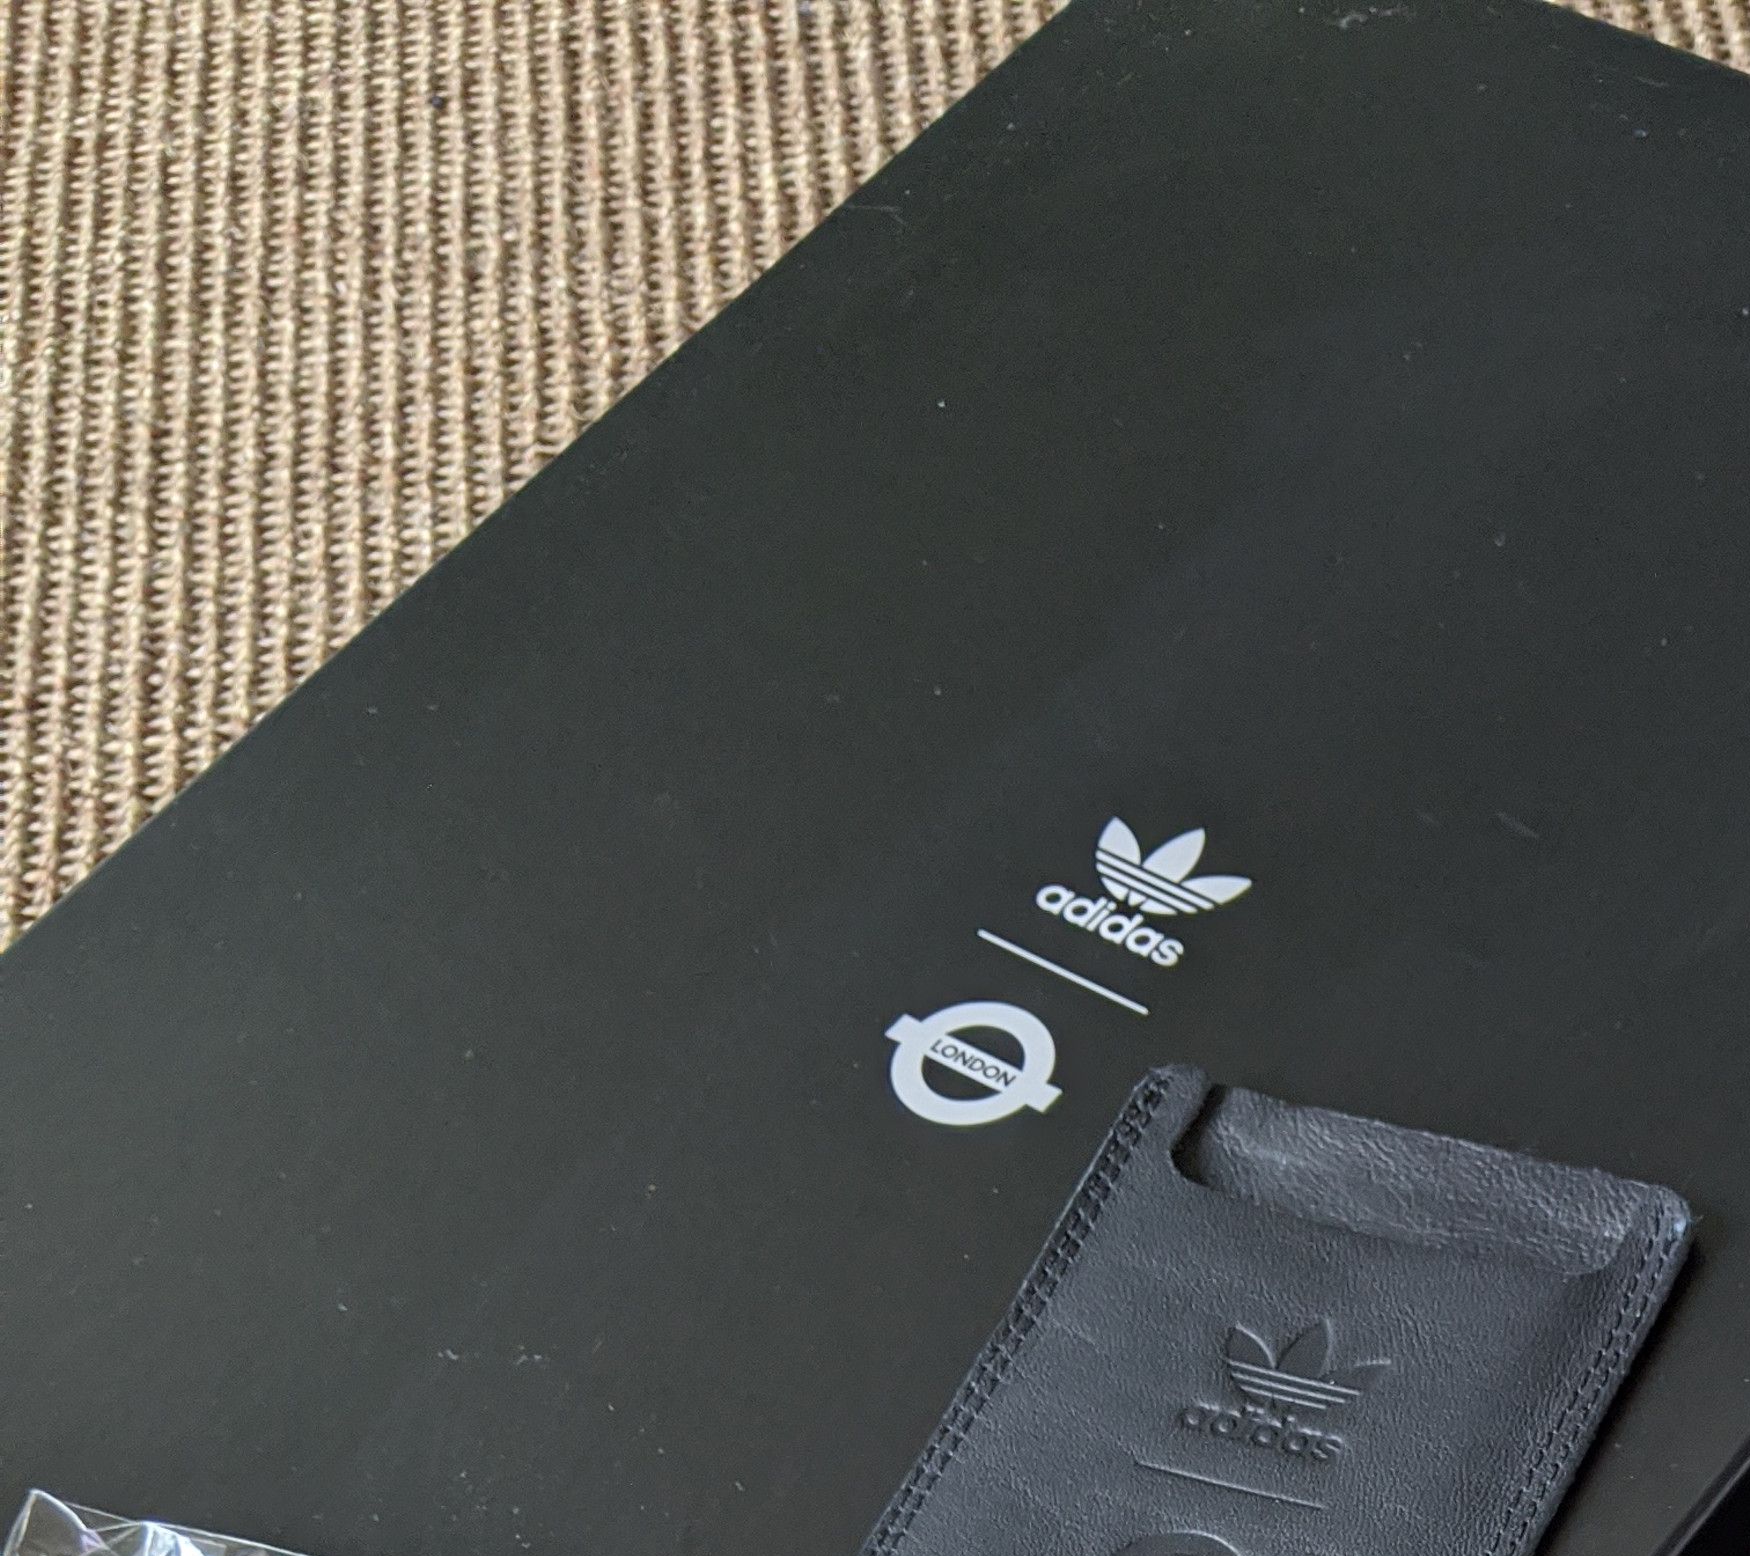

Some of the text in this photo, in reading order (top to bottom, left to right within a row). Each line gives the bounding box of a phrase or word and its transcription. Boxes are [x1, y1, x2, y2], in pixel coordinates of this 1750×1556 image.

[1035, 884, 1184, 967] adidas
[930, 1038, 1017, 1088] LONDON
[1181, 1400, 1344, 1461] adidas
